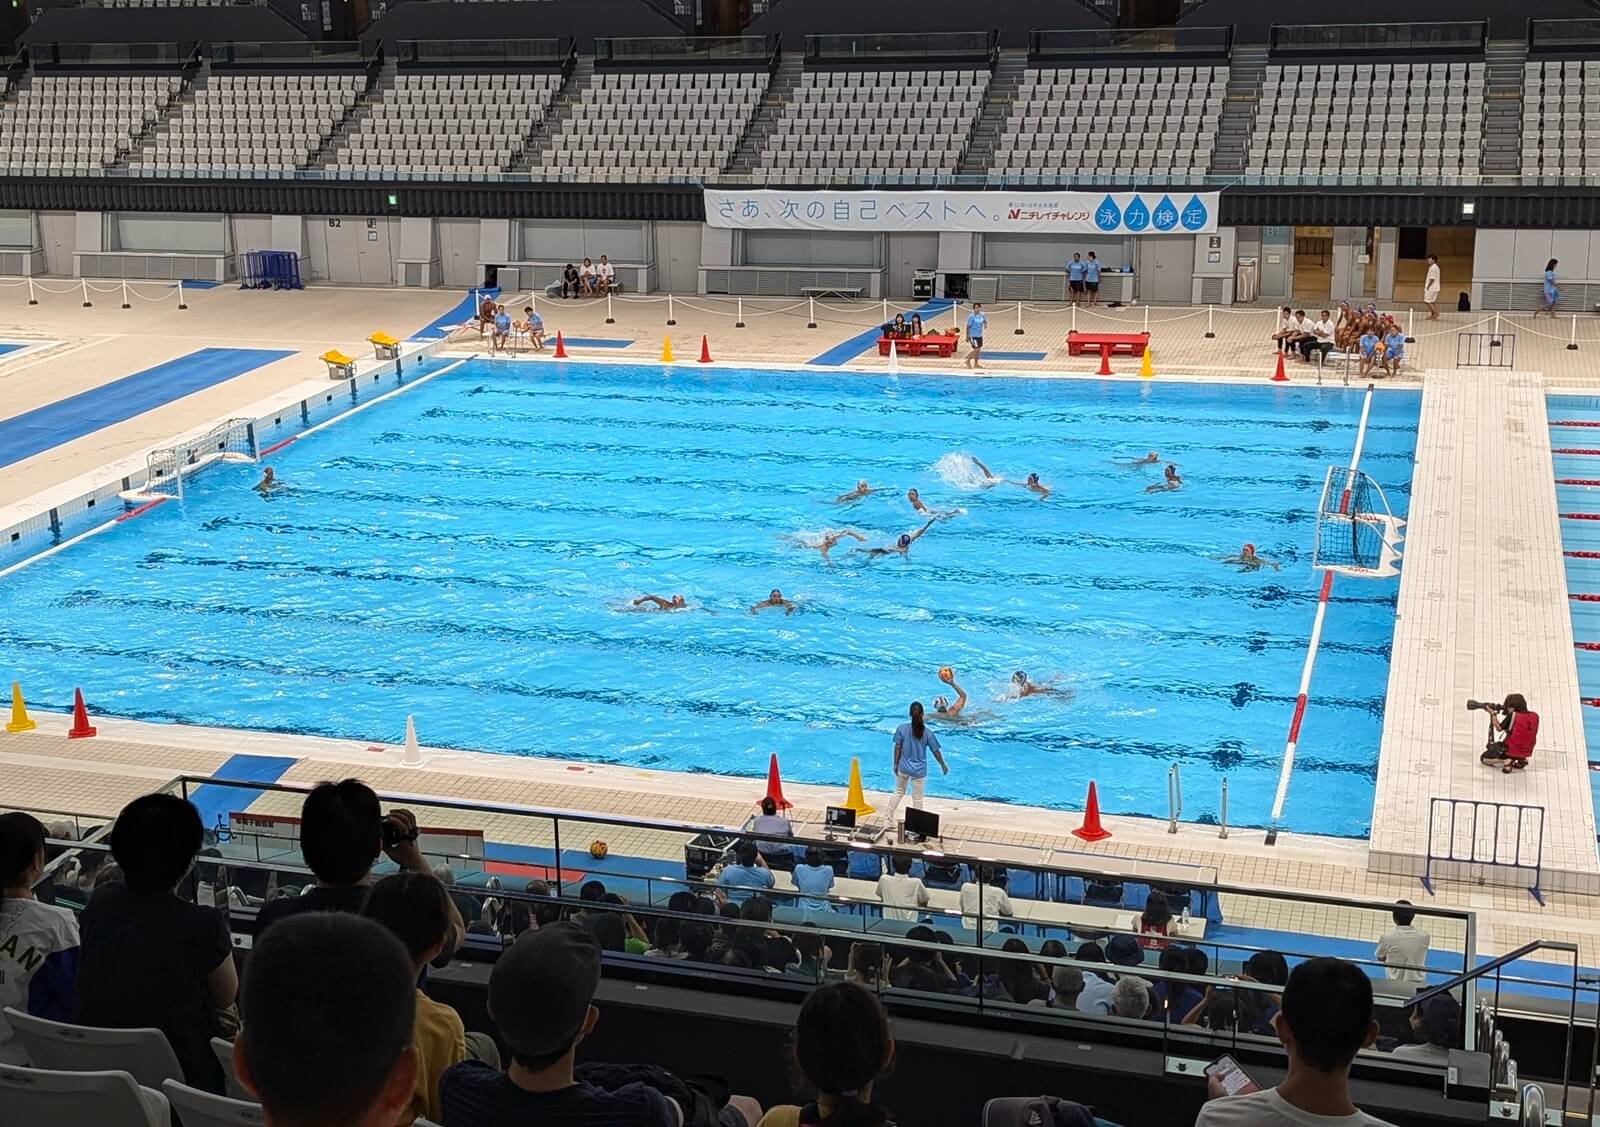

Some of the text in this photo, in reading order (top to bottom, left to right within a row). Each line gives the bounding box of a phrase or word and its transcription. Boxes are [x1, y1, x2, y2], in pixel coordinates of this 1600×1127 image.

[719, 199, 1000, 222] さあ、次の自己ベストへ。
[1021, 210, 1090, 221] ニチレイチャレンジ
[329, 218, 341, 228] B2
